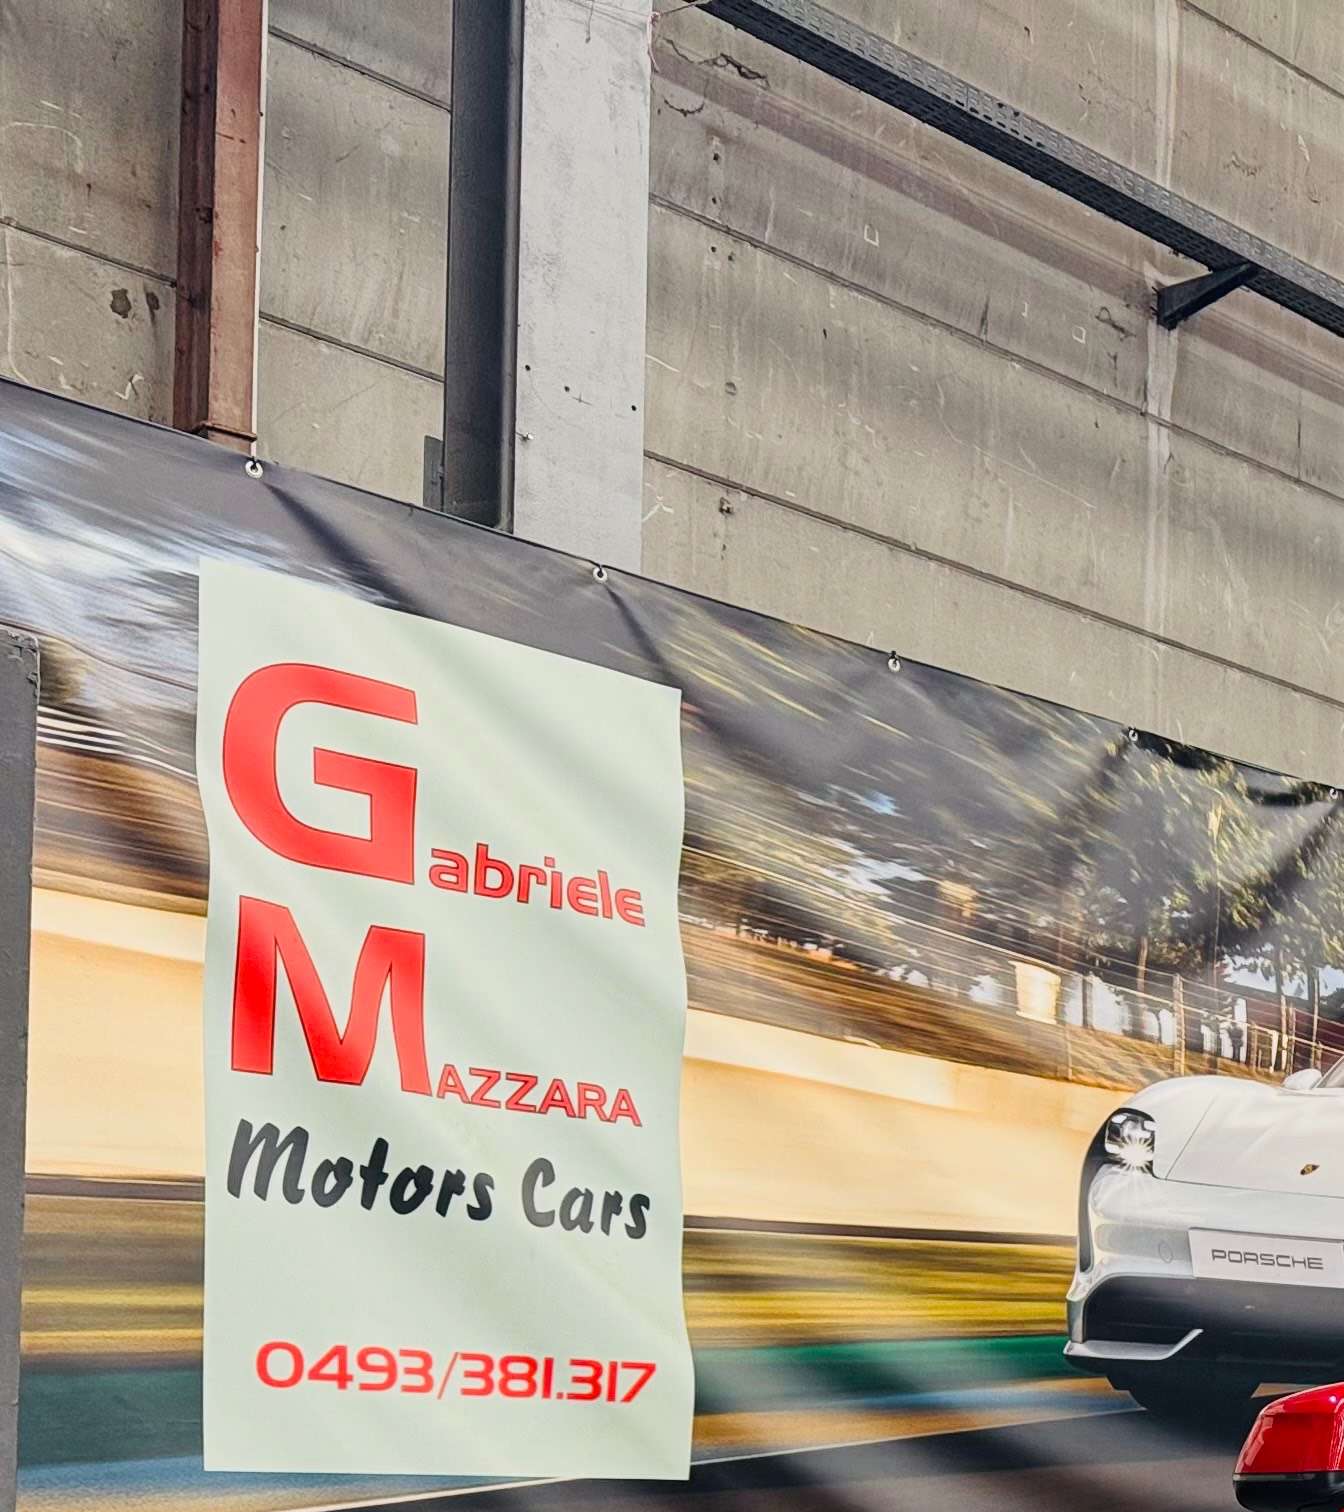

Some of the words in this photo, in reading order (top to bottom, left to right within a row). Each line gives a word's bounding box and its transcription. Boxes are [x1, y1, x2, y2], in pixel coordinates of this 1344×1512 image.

[223, 663, 645, 930] Gabriele
[231, 894, 642, 1127] MAZZARA
[227, 1119, 495, 1221] Motors
[521, 1156, 651, 1240] Cars
[1210, 1247, 1324, 1271] PORSCHE
[256, 1340, 656, 1404] 0493/381.317
